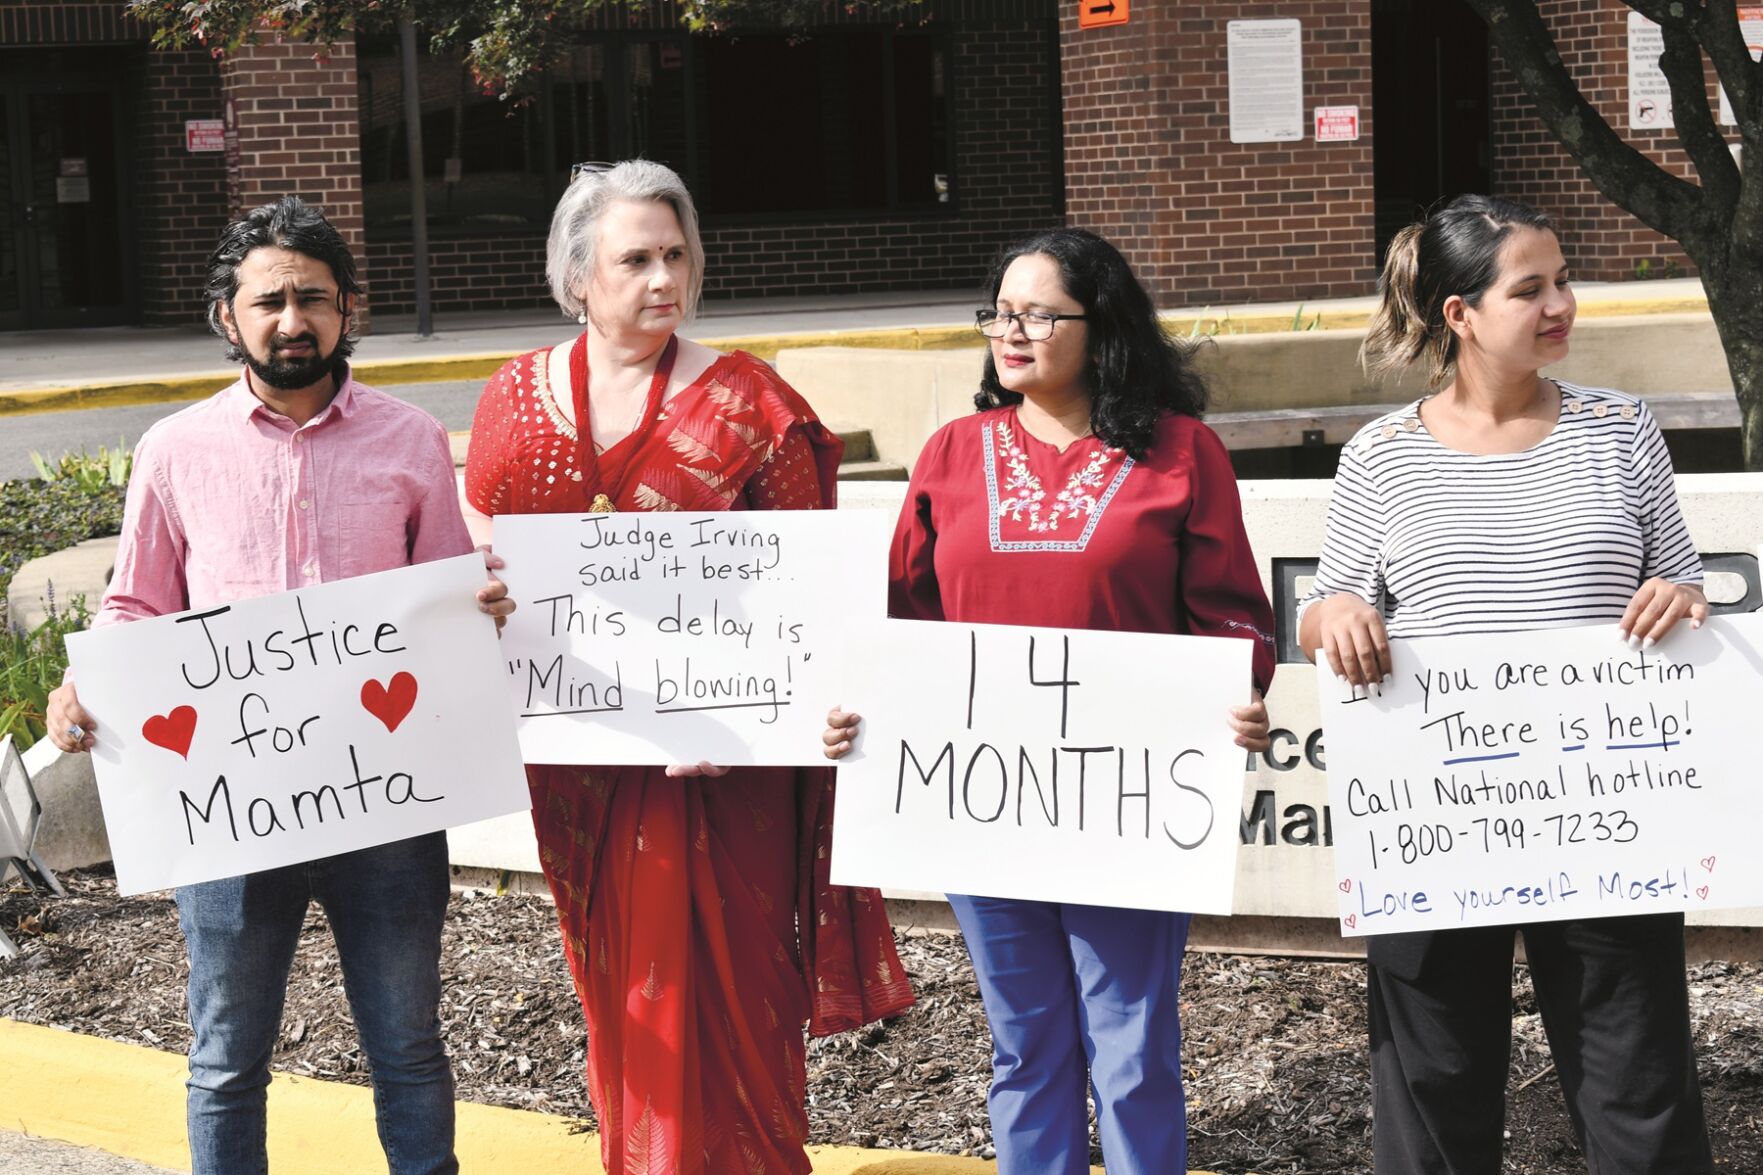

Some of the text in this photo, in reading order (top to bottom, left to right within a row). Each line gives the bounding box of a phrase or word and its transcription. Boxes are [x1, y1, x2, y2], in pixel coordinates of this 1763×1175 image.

[578, 557, 641, 587] said
[662, 555, 687, 579] it
[580, 516, 781, 569] Judge Irving
[175, 595, 407, 690] Justice
[532, 592, 804, 649] This delay is
[1414, 668, 1479, 714] you
[1494, 662, 1549, 691] are
[231, 692, 320, 759] for
[1420, 699, 1693, 753] There is help!
[179, 744, 446, 846] Mamta
[894, 738, 1215, 851] MONTHS
[1347, 758, 1704, 818] Call National hotline
[1368, 809, 1640, 871] 1-800-799-7233
[1357, 867, 1690, 922] Love yourself Most!
